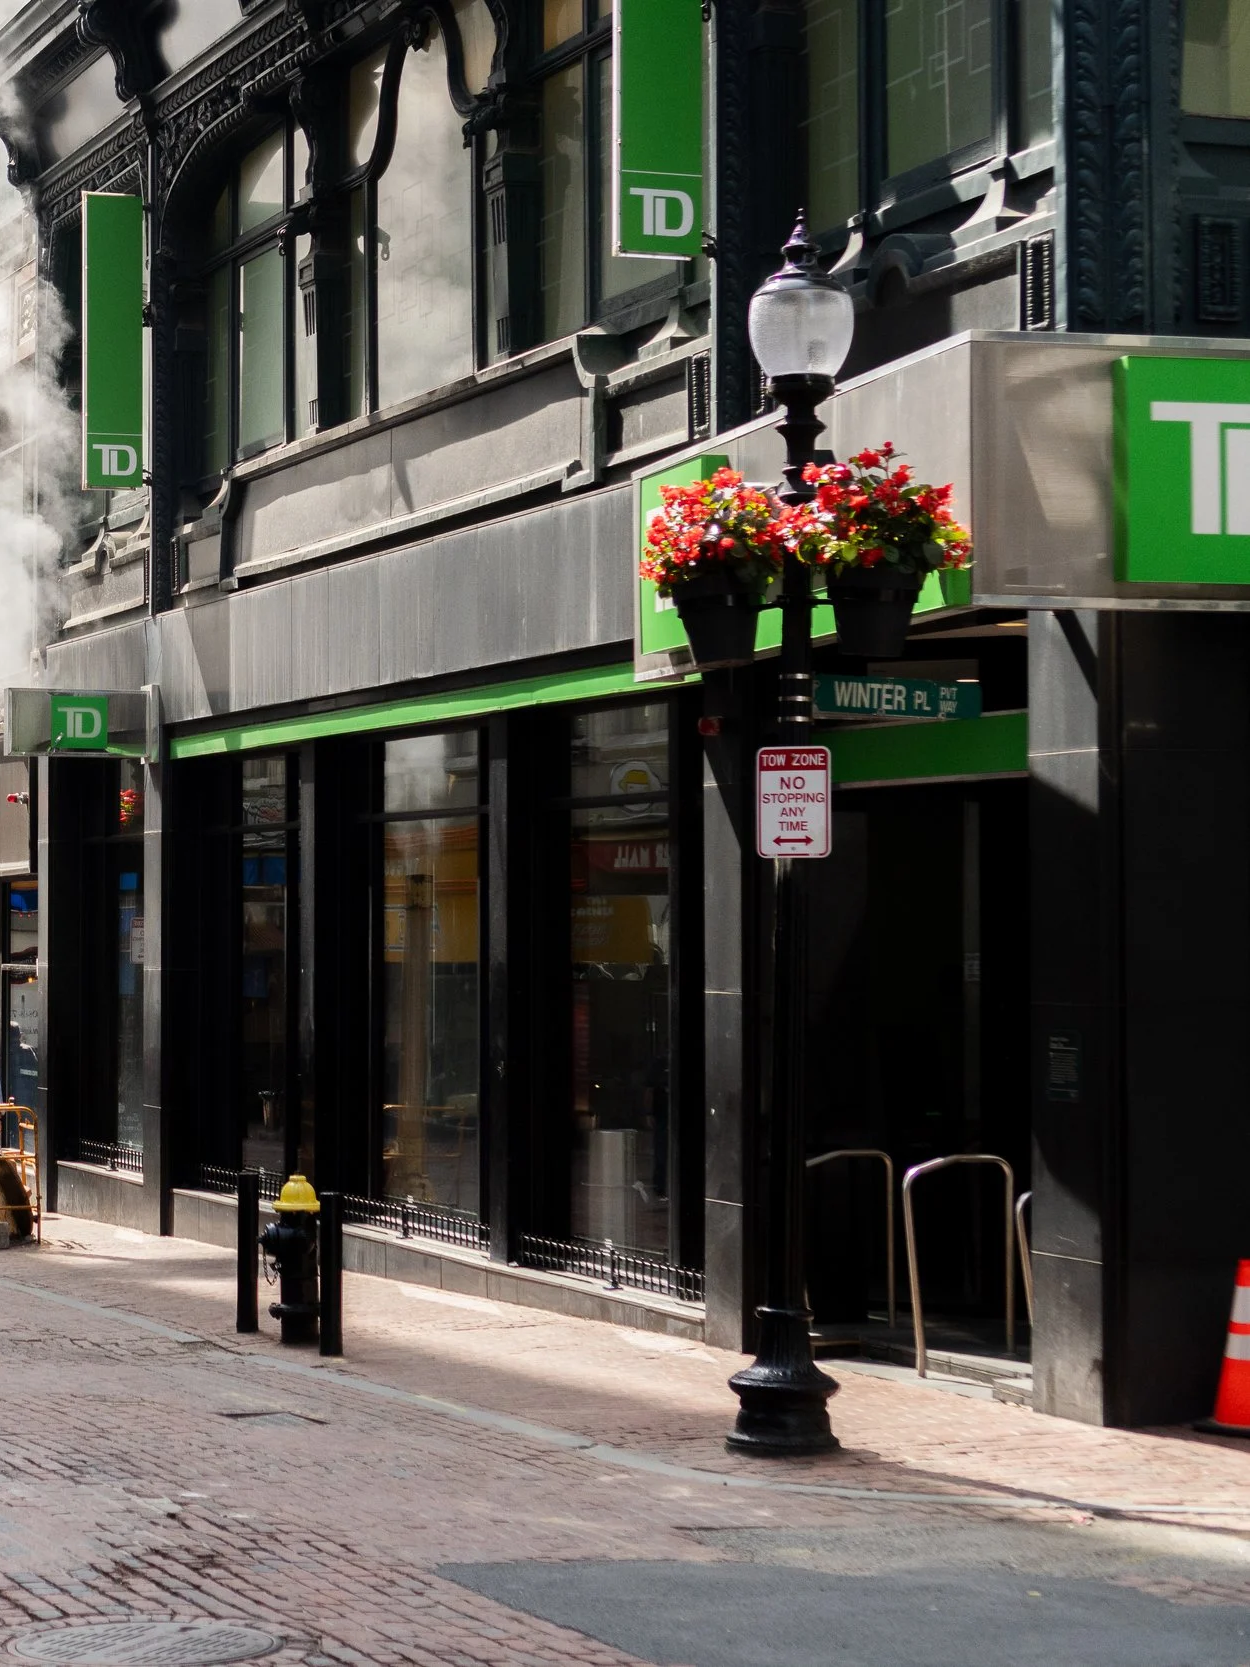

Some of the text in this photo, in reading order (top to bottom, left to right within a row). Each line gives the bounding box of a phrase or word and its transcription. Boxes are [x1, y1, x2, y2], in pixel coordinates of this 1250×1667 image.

[629, 187, 694, 237] TD
[92, 444, 138, 476] TD
[834, 681, 931, 711] WINTER PL
[939, 687, 958, 699] PVT
[939, 700, 958, 713] WAY
[57, 706, 102, 738] TD
[761, 753, 826, 767] TOW ZONE
[780, 776, 806, 790] NO
[762, 793, 825, 804] STOPPING
[780, 807, 806, 818] ANY
[778, 821, 808, 831] TIME
